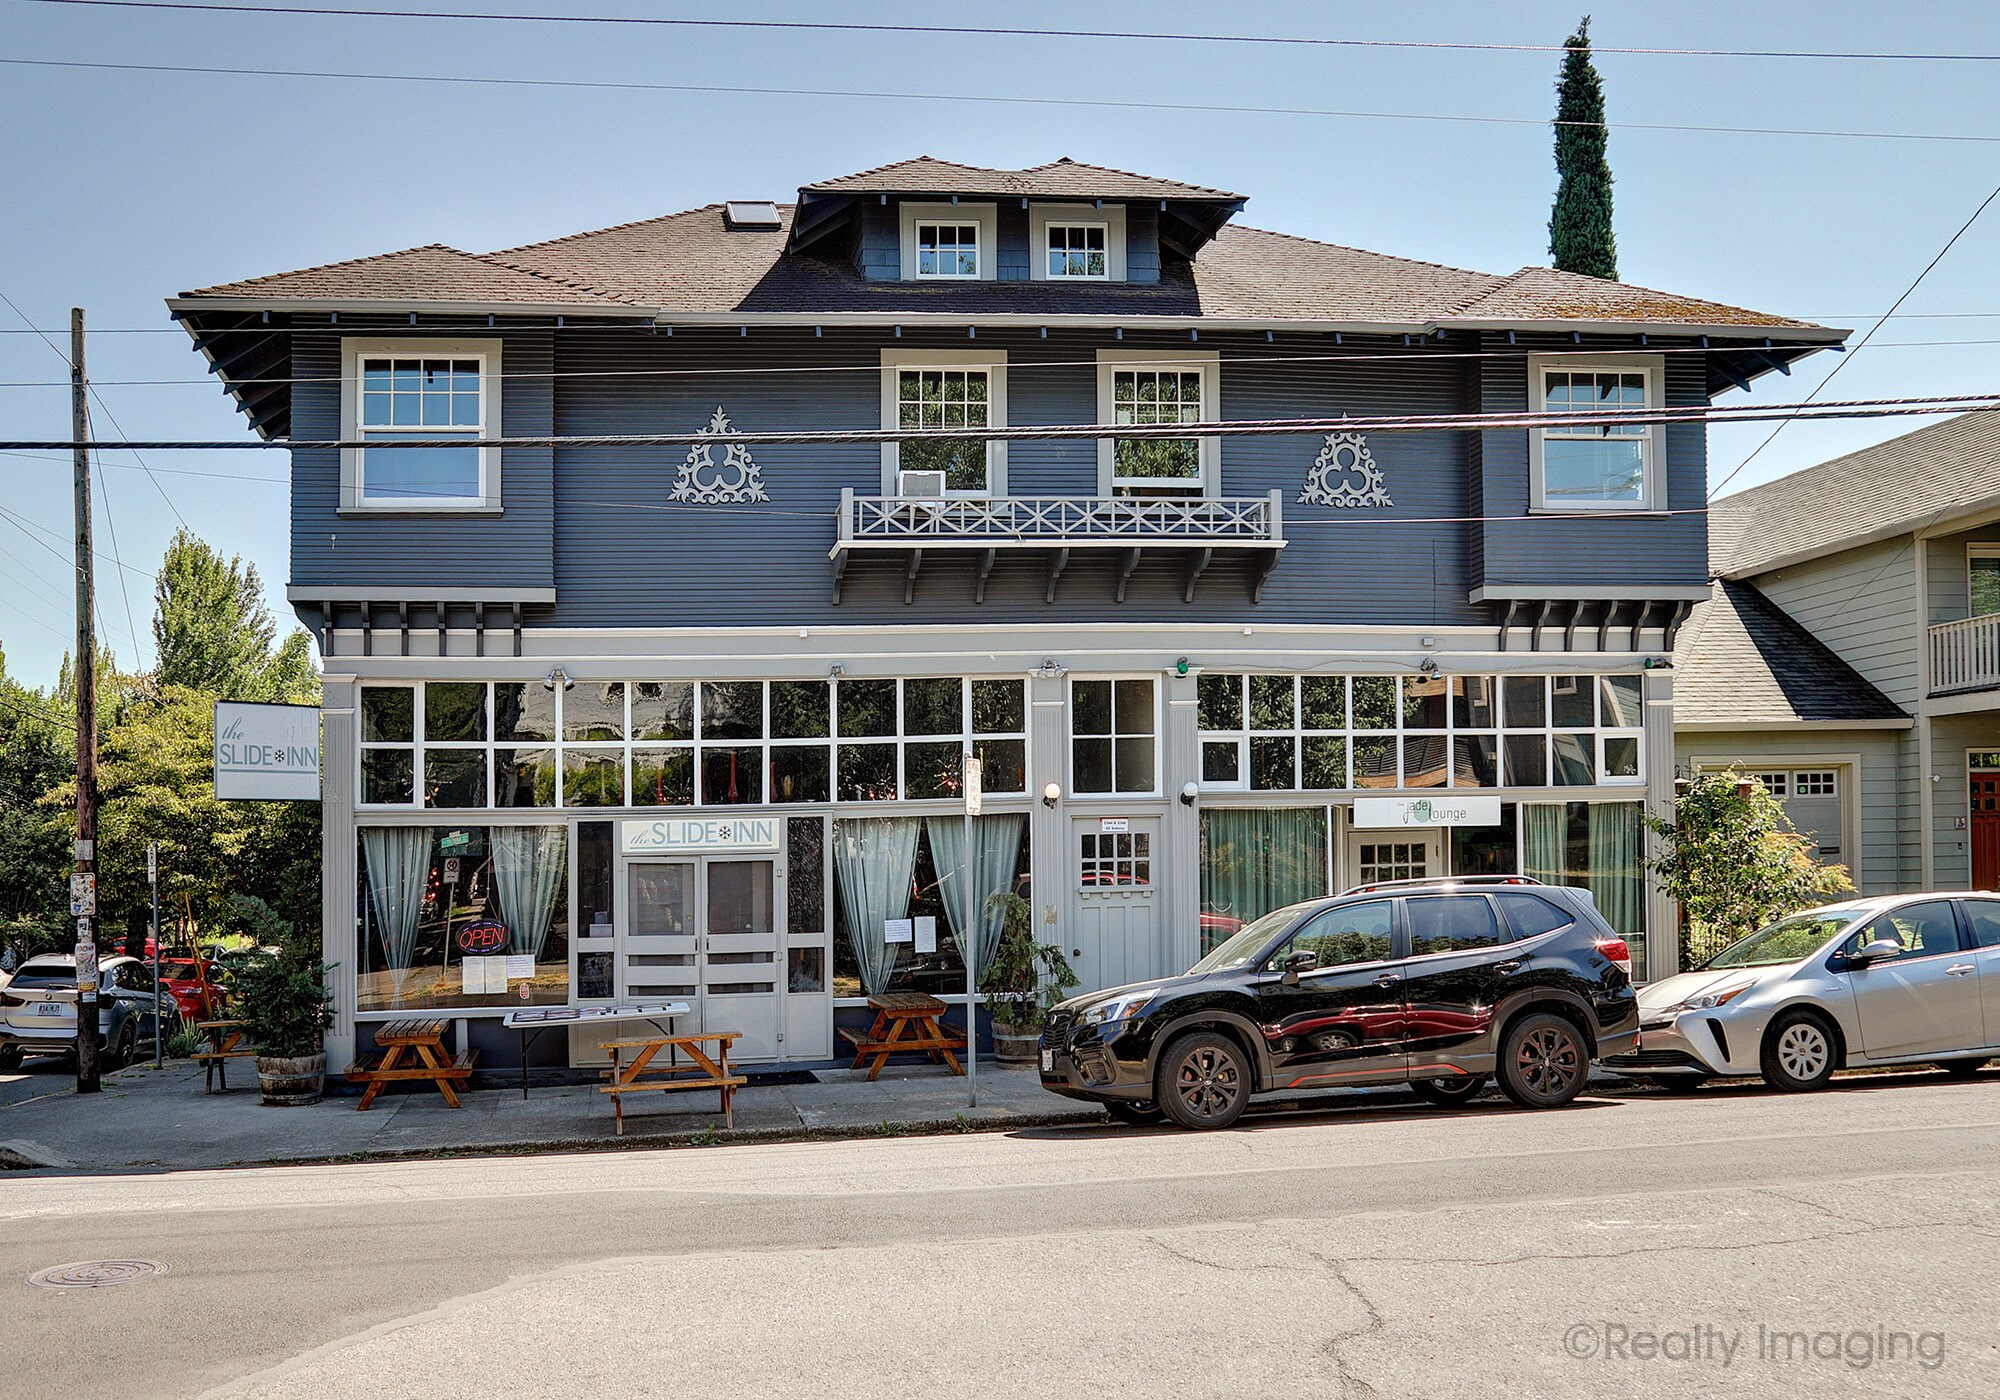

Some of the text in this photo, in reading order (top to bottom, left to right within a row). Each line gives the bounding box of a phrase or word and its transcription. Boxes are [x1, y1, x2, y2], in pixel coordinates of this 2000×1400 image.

[222, 716, 244, 740] the
[219, 743, 317, 767] SLIDE INN
[630, 821, 772, 845] the SLIDE INN
[459, 926, 505, 949] OPEN
